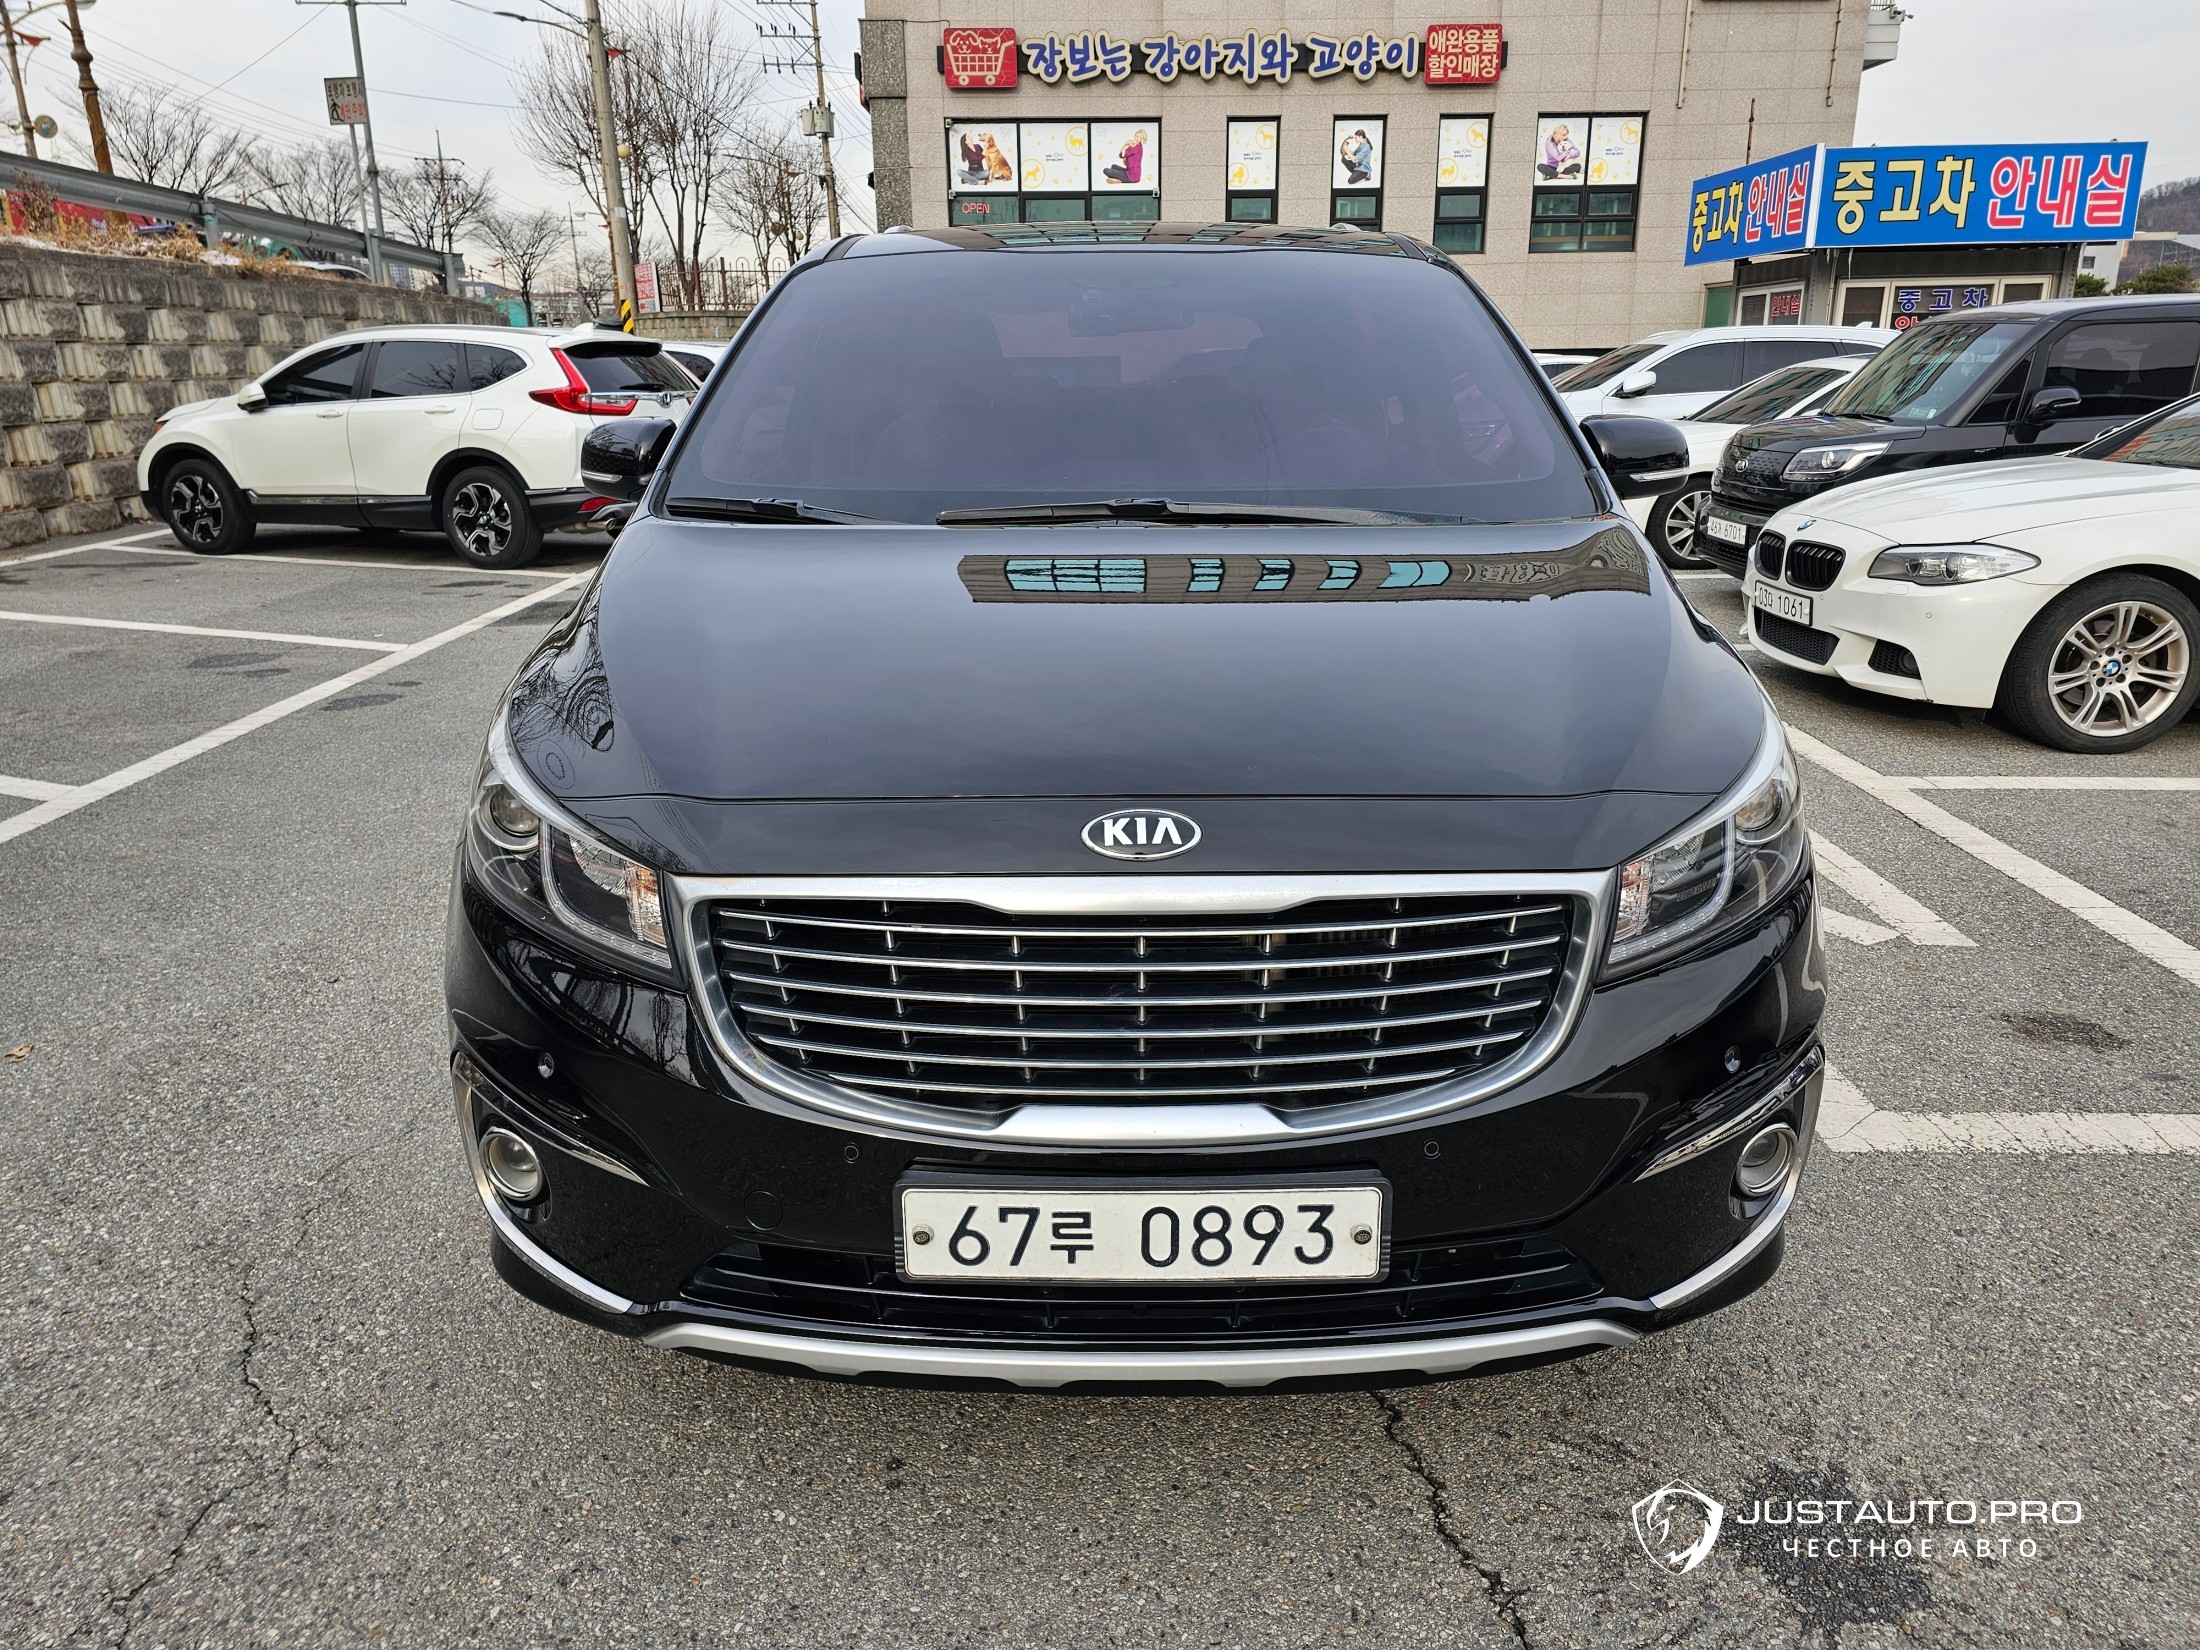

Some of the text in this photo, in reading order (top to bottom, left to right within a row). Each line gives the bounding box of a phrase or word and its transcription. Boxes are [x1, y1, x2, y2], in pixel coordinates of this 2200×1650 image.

[1429, 29, 1499, 53] 애완용품
[1026, 33, 1418, 79] 장보는 강아지와 고양이
[1428, 55, 1498, 78] 할인매장
[1833, 153, 2132, 235] 중고차 안내실
[961, 202, 990, 214] OPEN
[1692, 161, 1810, 254] 중고차 안내실
[1771, 294, 1801, 317] 안내실
[1898, 287, 1989, 313] 중고차
[1724, 523, 1741, 540] 6701
[1778, 595, 1803, 619] 1061
[1103, 817, 1183, 846] KIA
[947, 1204, 1336, 1267] 67루 0893
